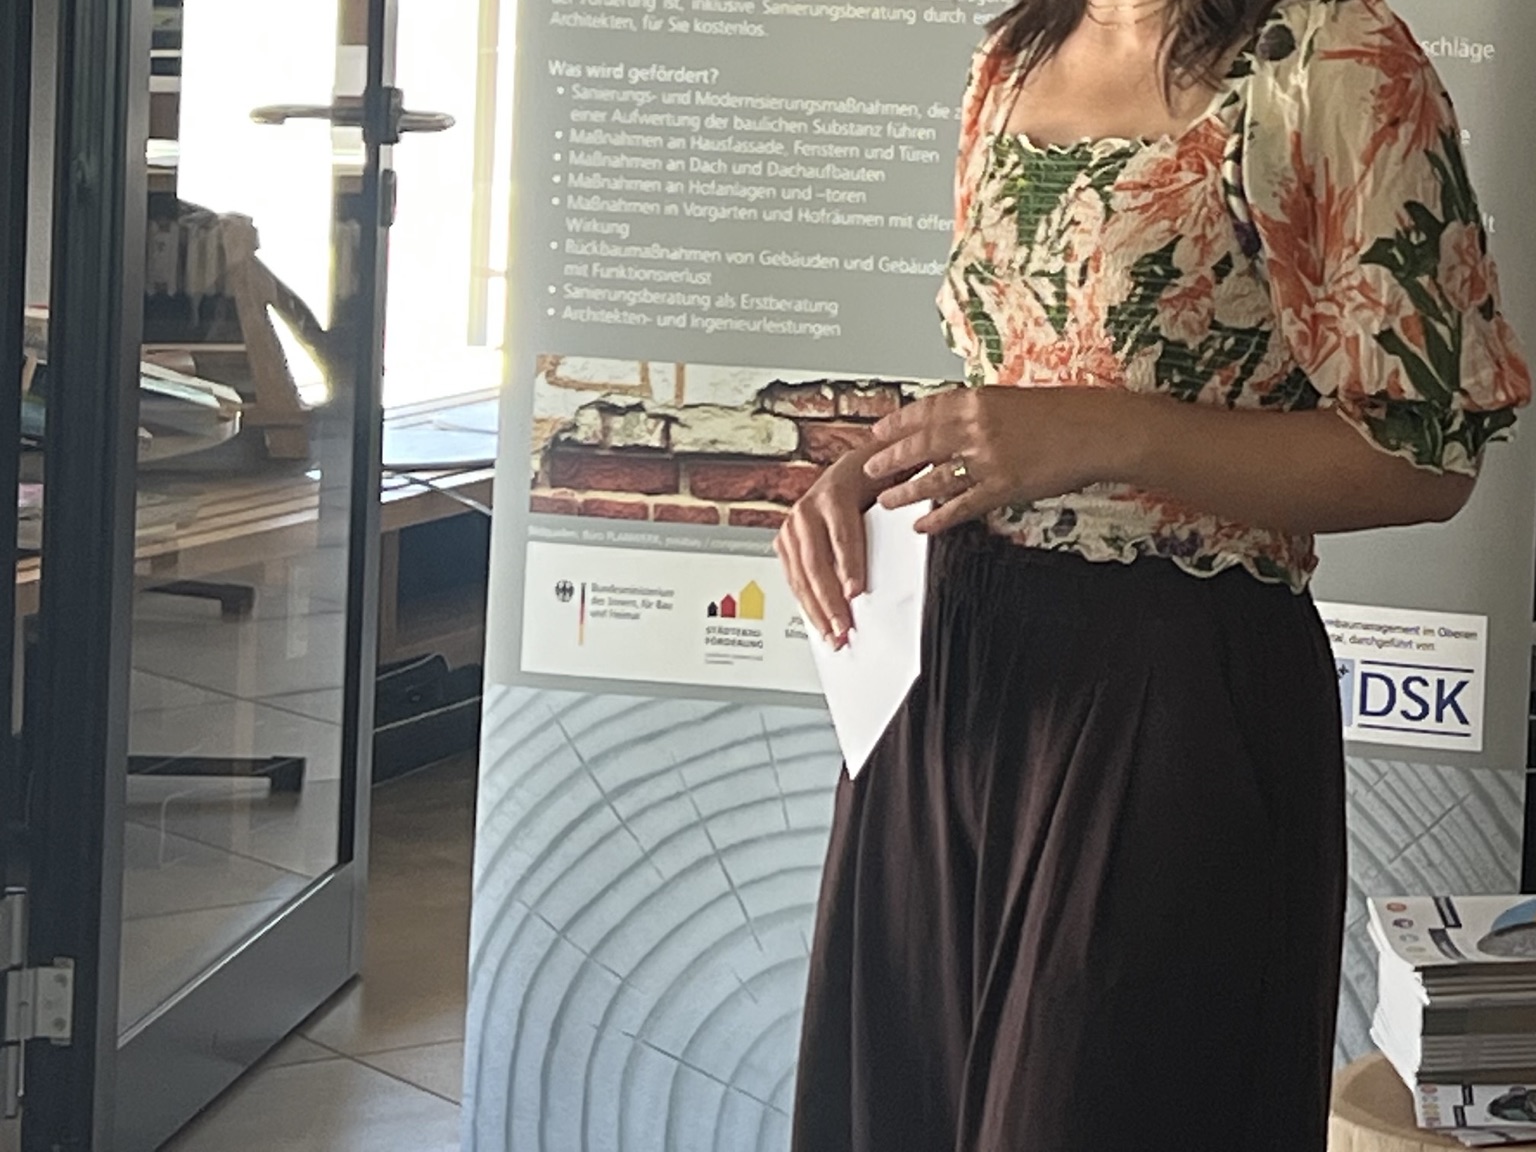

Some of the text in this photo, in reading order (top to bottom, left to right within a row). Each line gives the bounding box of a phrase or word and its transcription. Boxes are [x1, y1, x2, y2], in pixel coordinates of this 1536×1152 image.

[761, 0, 916, 26] Sanierungsberatung
[922, 7, 966, 24] durch
[547, 59, 719, 84] Was wird gefördert?
[661, 90, 691, 105] und
[926, 102, 949, 118] die
[570, 106, 936, 140] einer Aufwertung der baulichen Substanz führen
[666, 136, 687, 149] an
[793, 140, 859, 158] Fenstern
[863, 145, 893, 160] und
[897, 145, 940, 163] Türen
[665, 159, 685, 172] an
[689, 157, 728, 174] Dach
[731, 161, 762, 176] und
[766, 161, 885, 183] Dachaufbauten
[664, 181, 684, 194] an
[688, 179, 776, 203] Hofanlagen
[780, 186, 812, 201] und
[663, 200, 679, 216] in
[762, 207, 792, 222] und
[797, 208, 884, 227] Hofräumen
[888, 213, 914, 229] mit
[565, 217, 630, 240] Wirkung
[724, 251, 754, 264] von
[759, 250, 839, 269] Gebäuden
[843, 256, 874, 271] und
[562, 283, 711, 312] Sanierungsberatung
[740, 294, 838, 319] Erstberatung
[656, 312, 687, 328] und
[690, 313, 840, 340] Ingenieurleistungen
[1359, 670, 1470, 726] DSK
